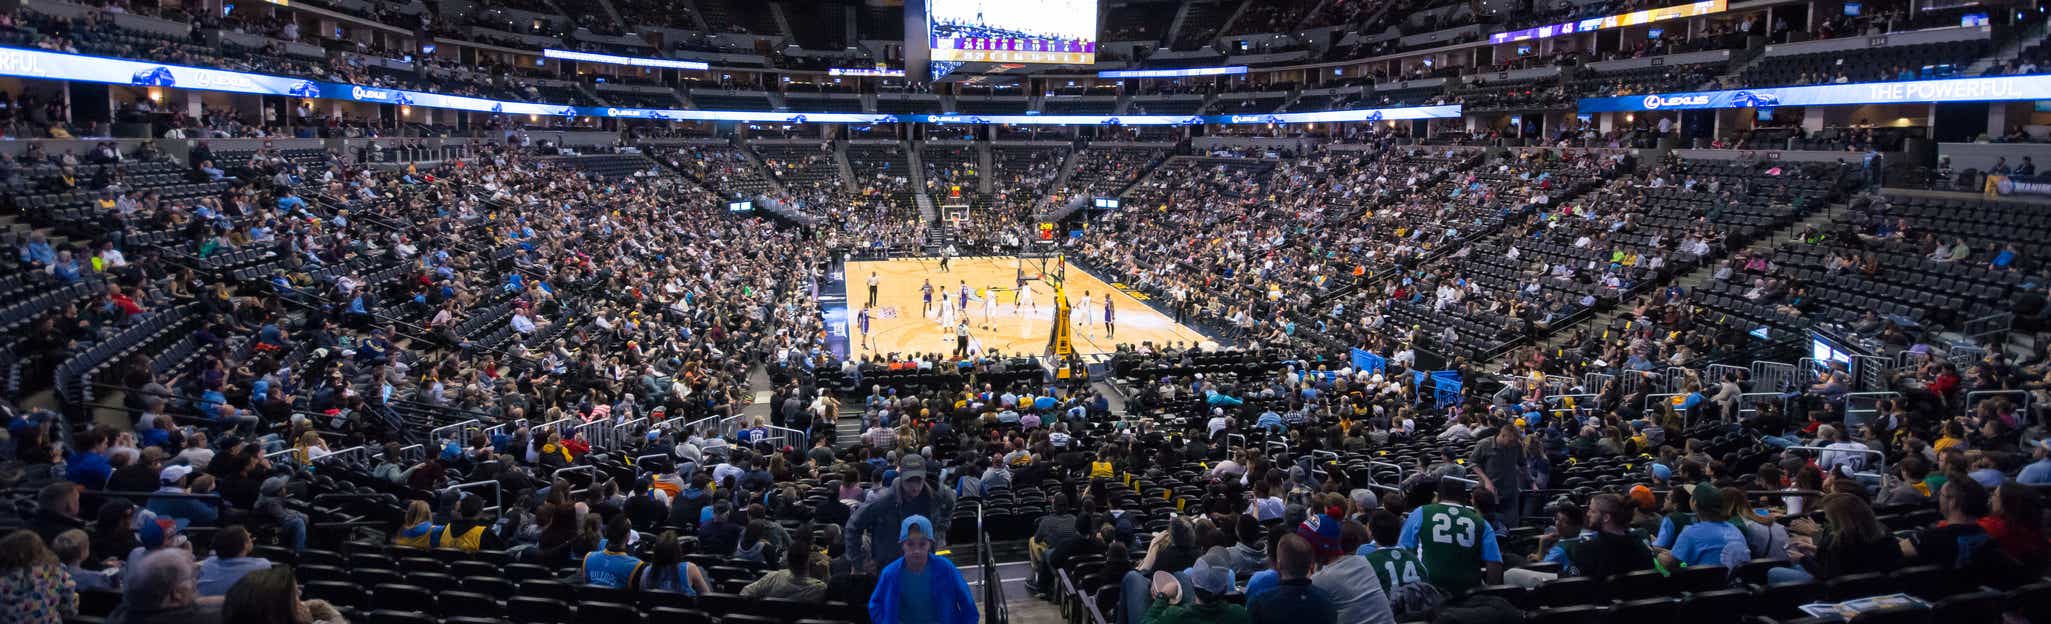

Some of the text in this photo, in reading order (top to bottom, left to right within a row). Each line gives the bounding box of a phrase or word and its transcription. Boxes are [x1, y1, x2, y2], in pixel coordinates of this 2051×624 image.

[1660, 95, 1709, 107] LEXUS
[1870, 79, 2022, 100] THE POWERFUL,
[1432, 512, 1476, 548] 23
[1384, 560, 1421, 588] 14
